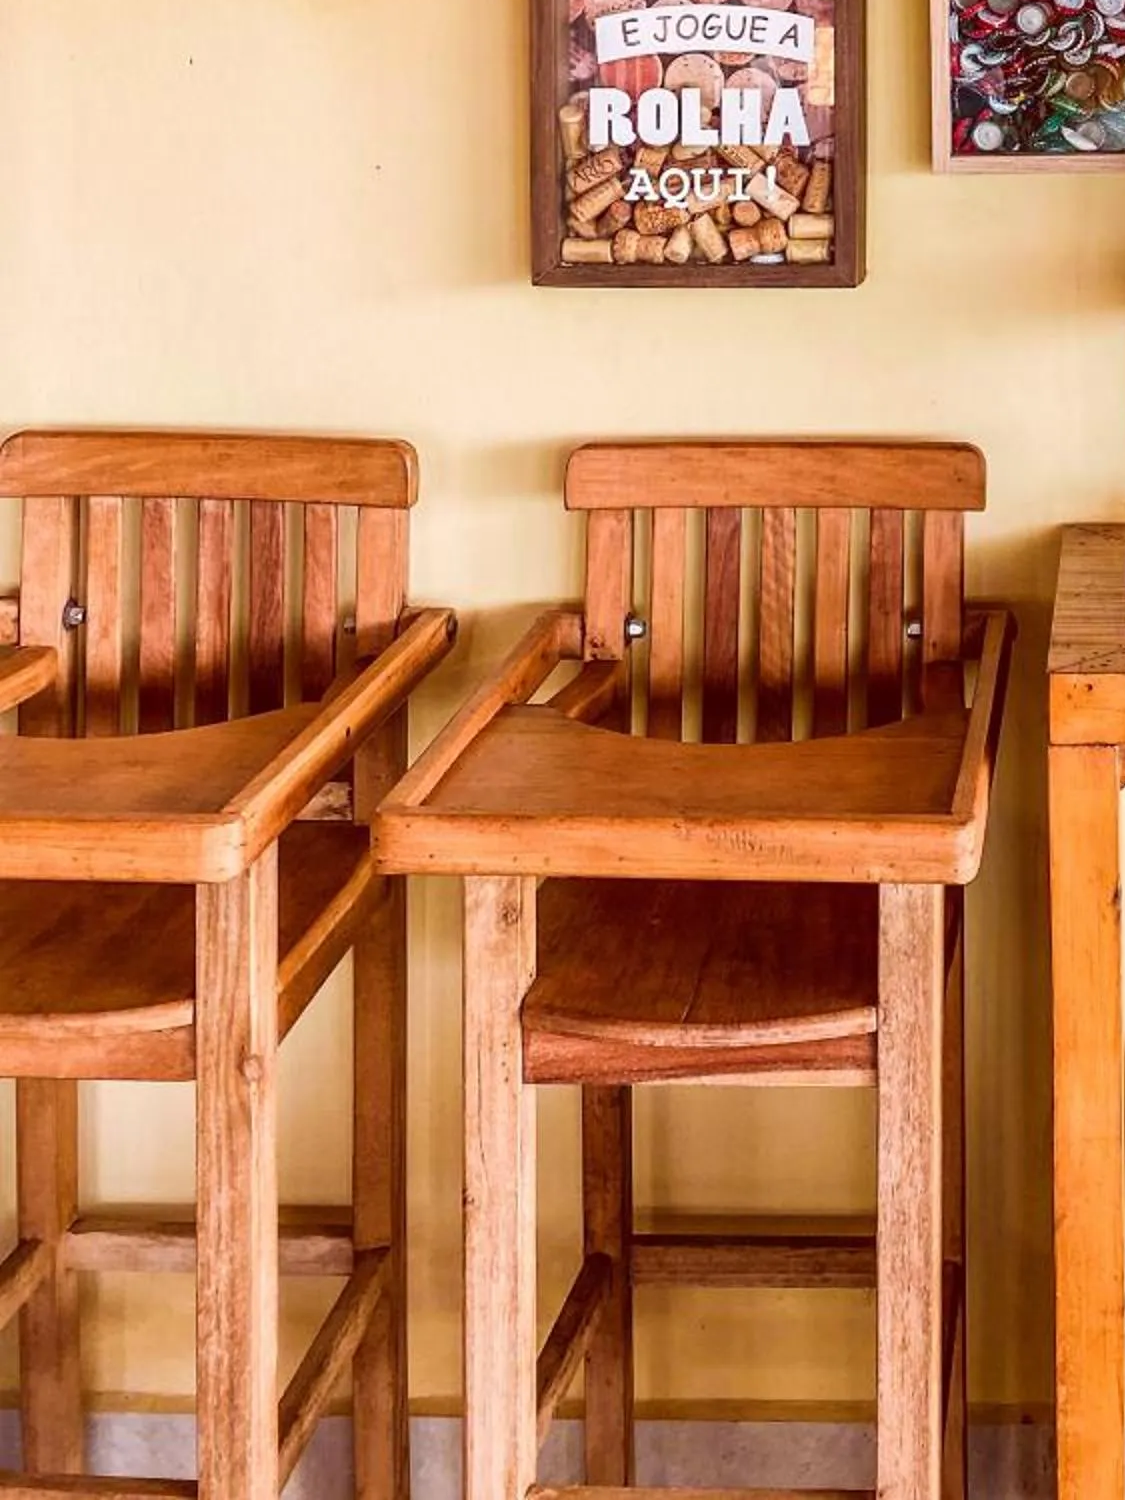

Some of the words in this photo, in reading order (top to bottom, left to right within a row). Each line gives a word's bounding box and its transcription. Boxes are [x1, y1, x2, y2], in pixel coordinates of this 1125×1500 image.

[621, 18, 641, 46] E
[652, 13, 769, 43] JOGUE
[779, 23, 799, 47] A
[588, 87, 811, 147] ROLHA
